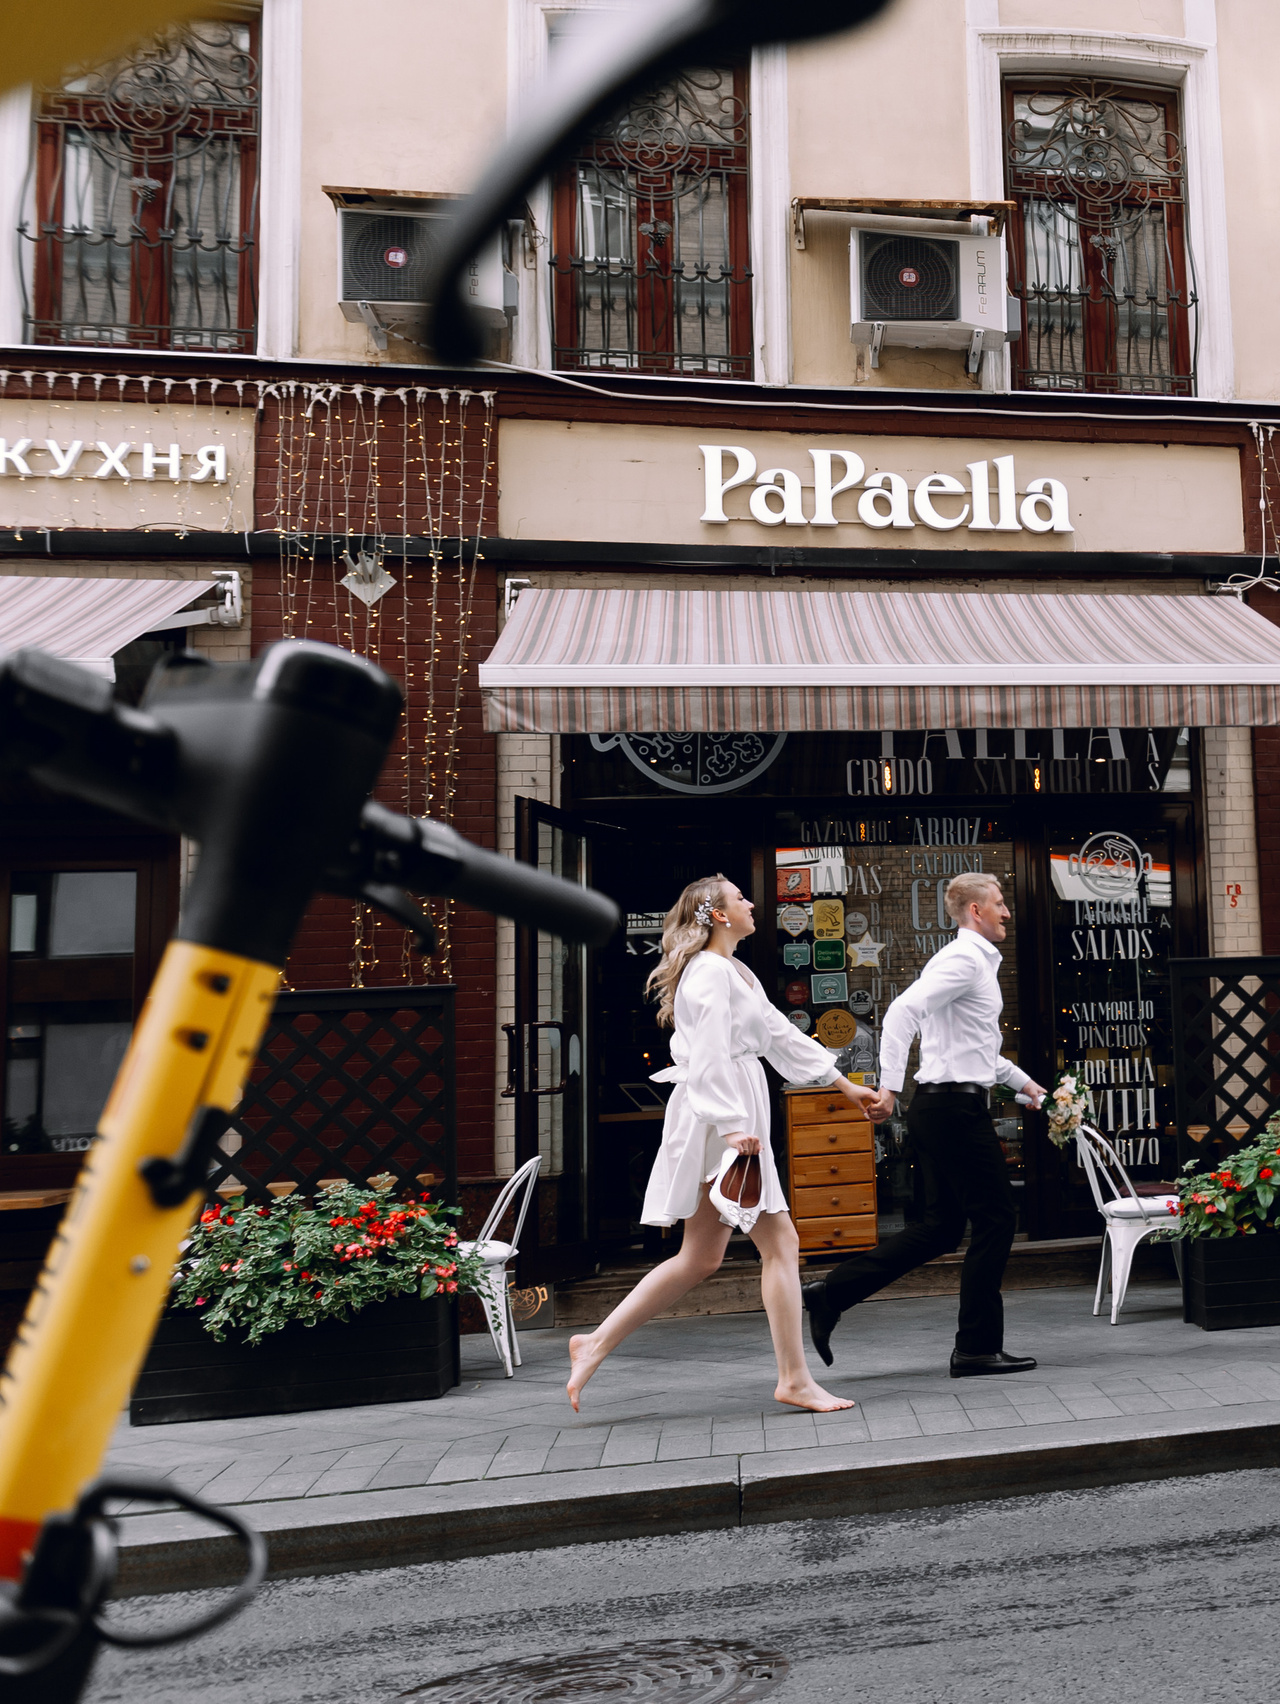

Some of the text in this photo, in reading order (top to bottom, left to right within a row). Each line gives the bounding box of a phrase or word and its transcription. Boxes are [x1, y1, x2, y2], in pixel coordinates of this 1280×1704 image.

[0, 437, 228, 483] КУХНЯ
[698, 445, 1076, 534] PaPaella
[846, 757, 933, 796] CRUDO
[912, 817, 981, 847] ARROZ
[911, 852, 984, 876] CALDOSO
[811, 864, 883, 896] TAPAS
[1230, 895, 1238, 908] 5
[1071, 928, 1153, 961] SALADS
[1071, 1000, 1155, 1023] SALMOREJO
[1078, 1024, 1148, 1049] PINCHOS
[1072, 1057, 1155, 1086] TORTILLA
